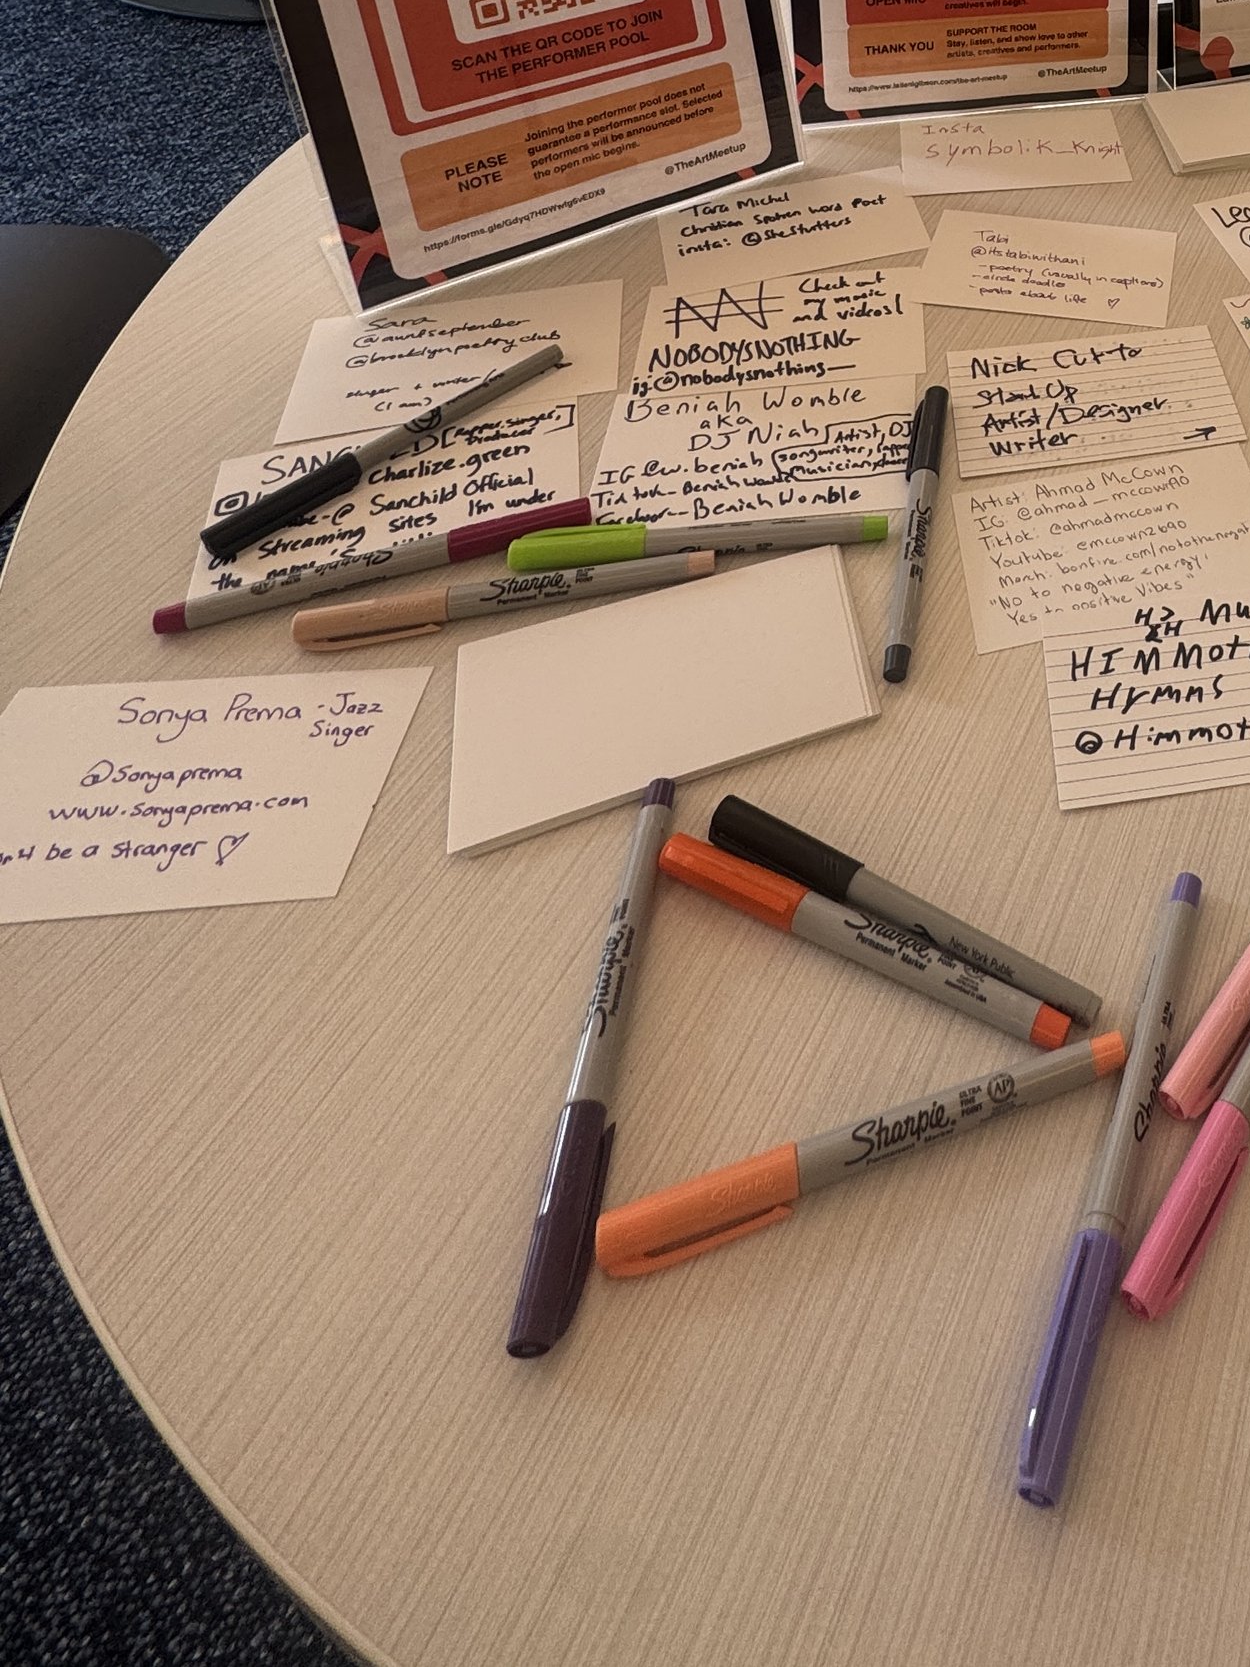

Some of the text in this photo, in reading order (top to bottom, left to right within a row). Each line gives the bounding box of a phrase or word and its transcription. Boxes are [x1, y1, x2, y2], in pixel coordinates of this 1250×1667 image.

[451, 9, 663, 72] SCAN THE QR CODE TO JOIN
[864, 41, 934, 56] THANK YOU
[474, 30, 650, 84] THE PERFORMER POOL
[1037, 65, 1108, 78] @TheArtMeetup
[524, 82, 706, 143] Joining the performer pool does not
[444, 152, 509, 181] PLEASE
[664, 142, 747, 176] @TheArtMeetup
[457, 170, 504, 193] NOTE
[679, 202, 730, 217] Tara
[624, 391, 740, 422] Beniah
[1034, 462, 1184, 499] Ahmad McCown
[480, 572, 567, 602] Sharpie
[117, 691, 384, 744] Sonya Prema Jazz
[308, 720, 374, 747] Singer
[45, 838, 208, 872] be a stranger
[844, 1100, 951, 1167] Sharpie
